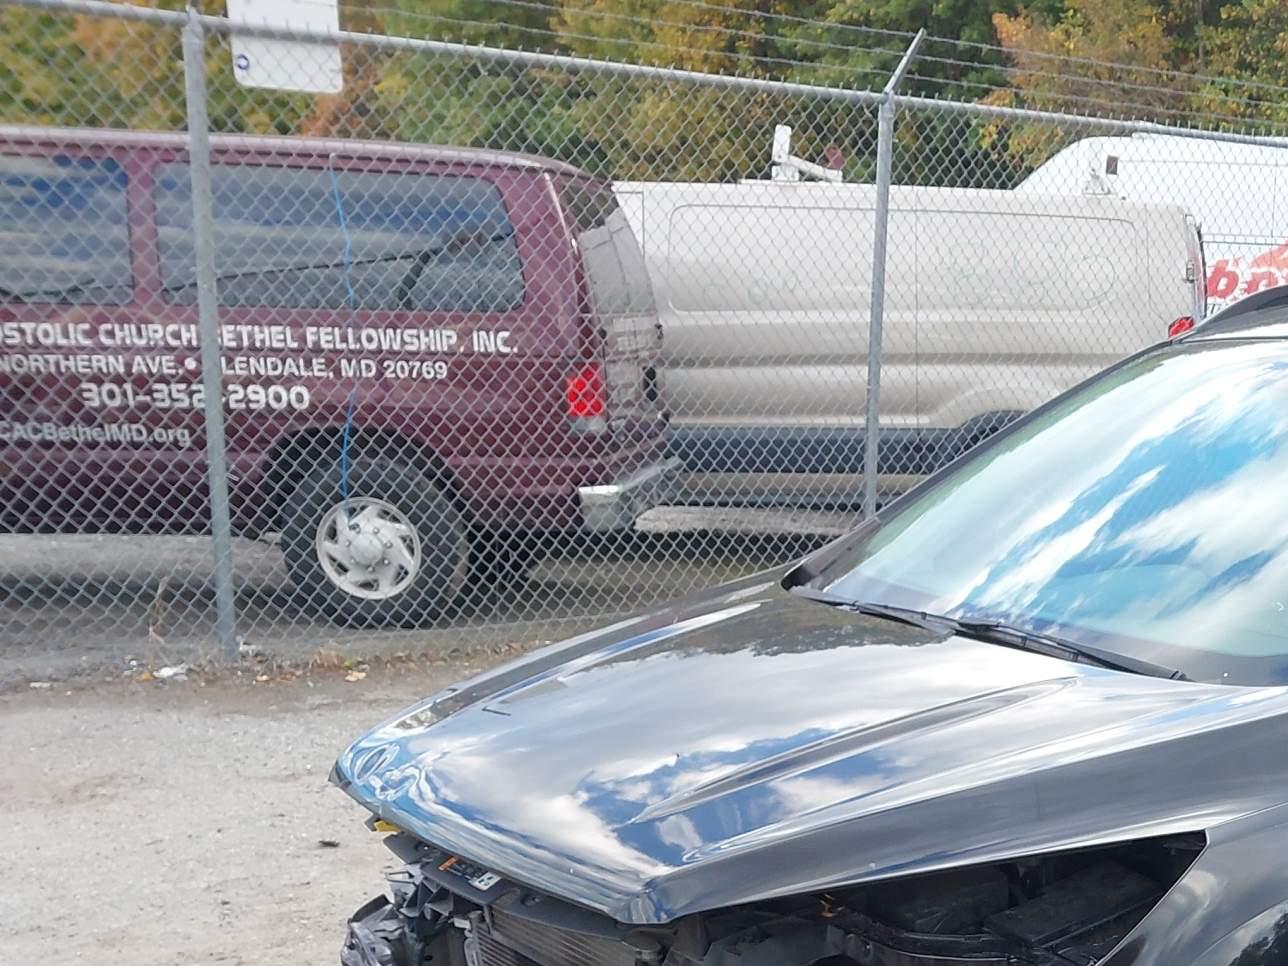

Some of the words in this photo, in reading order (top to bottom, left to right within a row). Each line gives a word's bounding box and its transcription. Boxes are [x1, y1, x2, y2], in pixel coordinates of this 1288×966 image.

[0, 322, 92, 346] STOLIC
[99, 323, 199, 347] CHURCH
[217, 324, 298, 349] ETHEL
[472, 330, 519, 354] INC.
[131, 356, 184, 376] AVE.
[220, 356, 334, 379] LENDALE,
[340, 358, 376, 379] MD
[382, 360, 448, 380] 20769
[80, 382, 310, 410] 301-3522900
